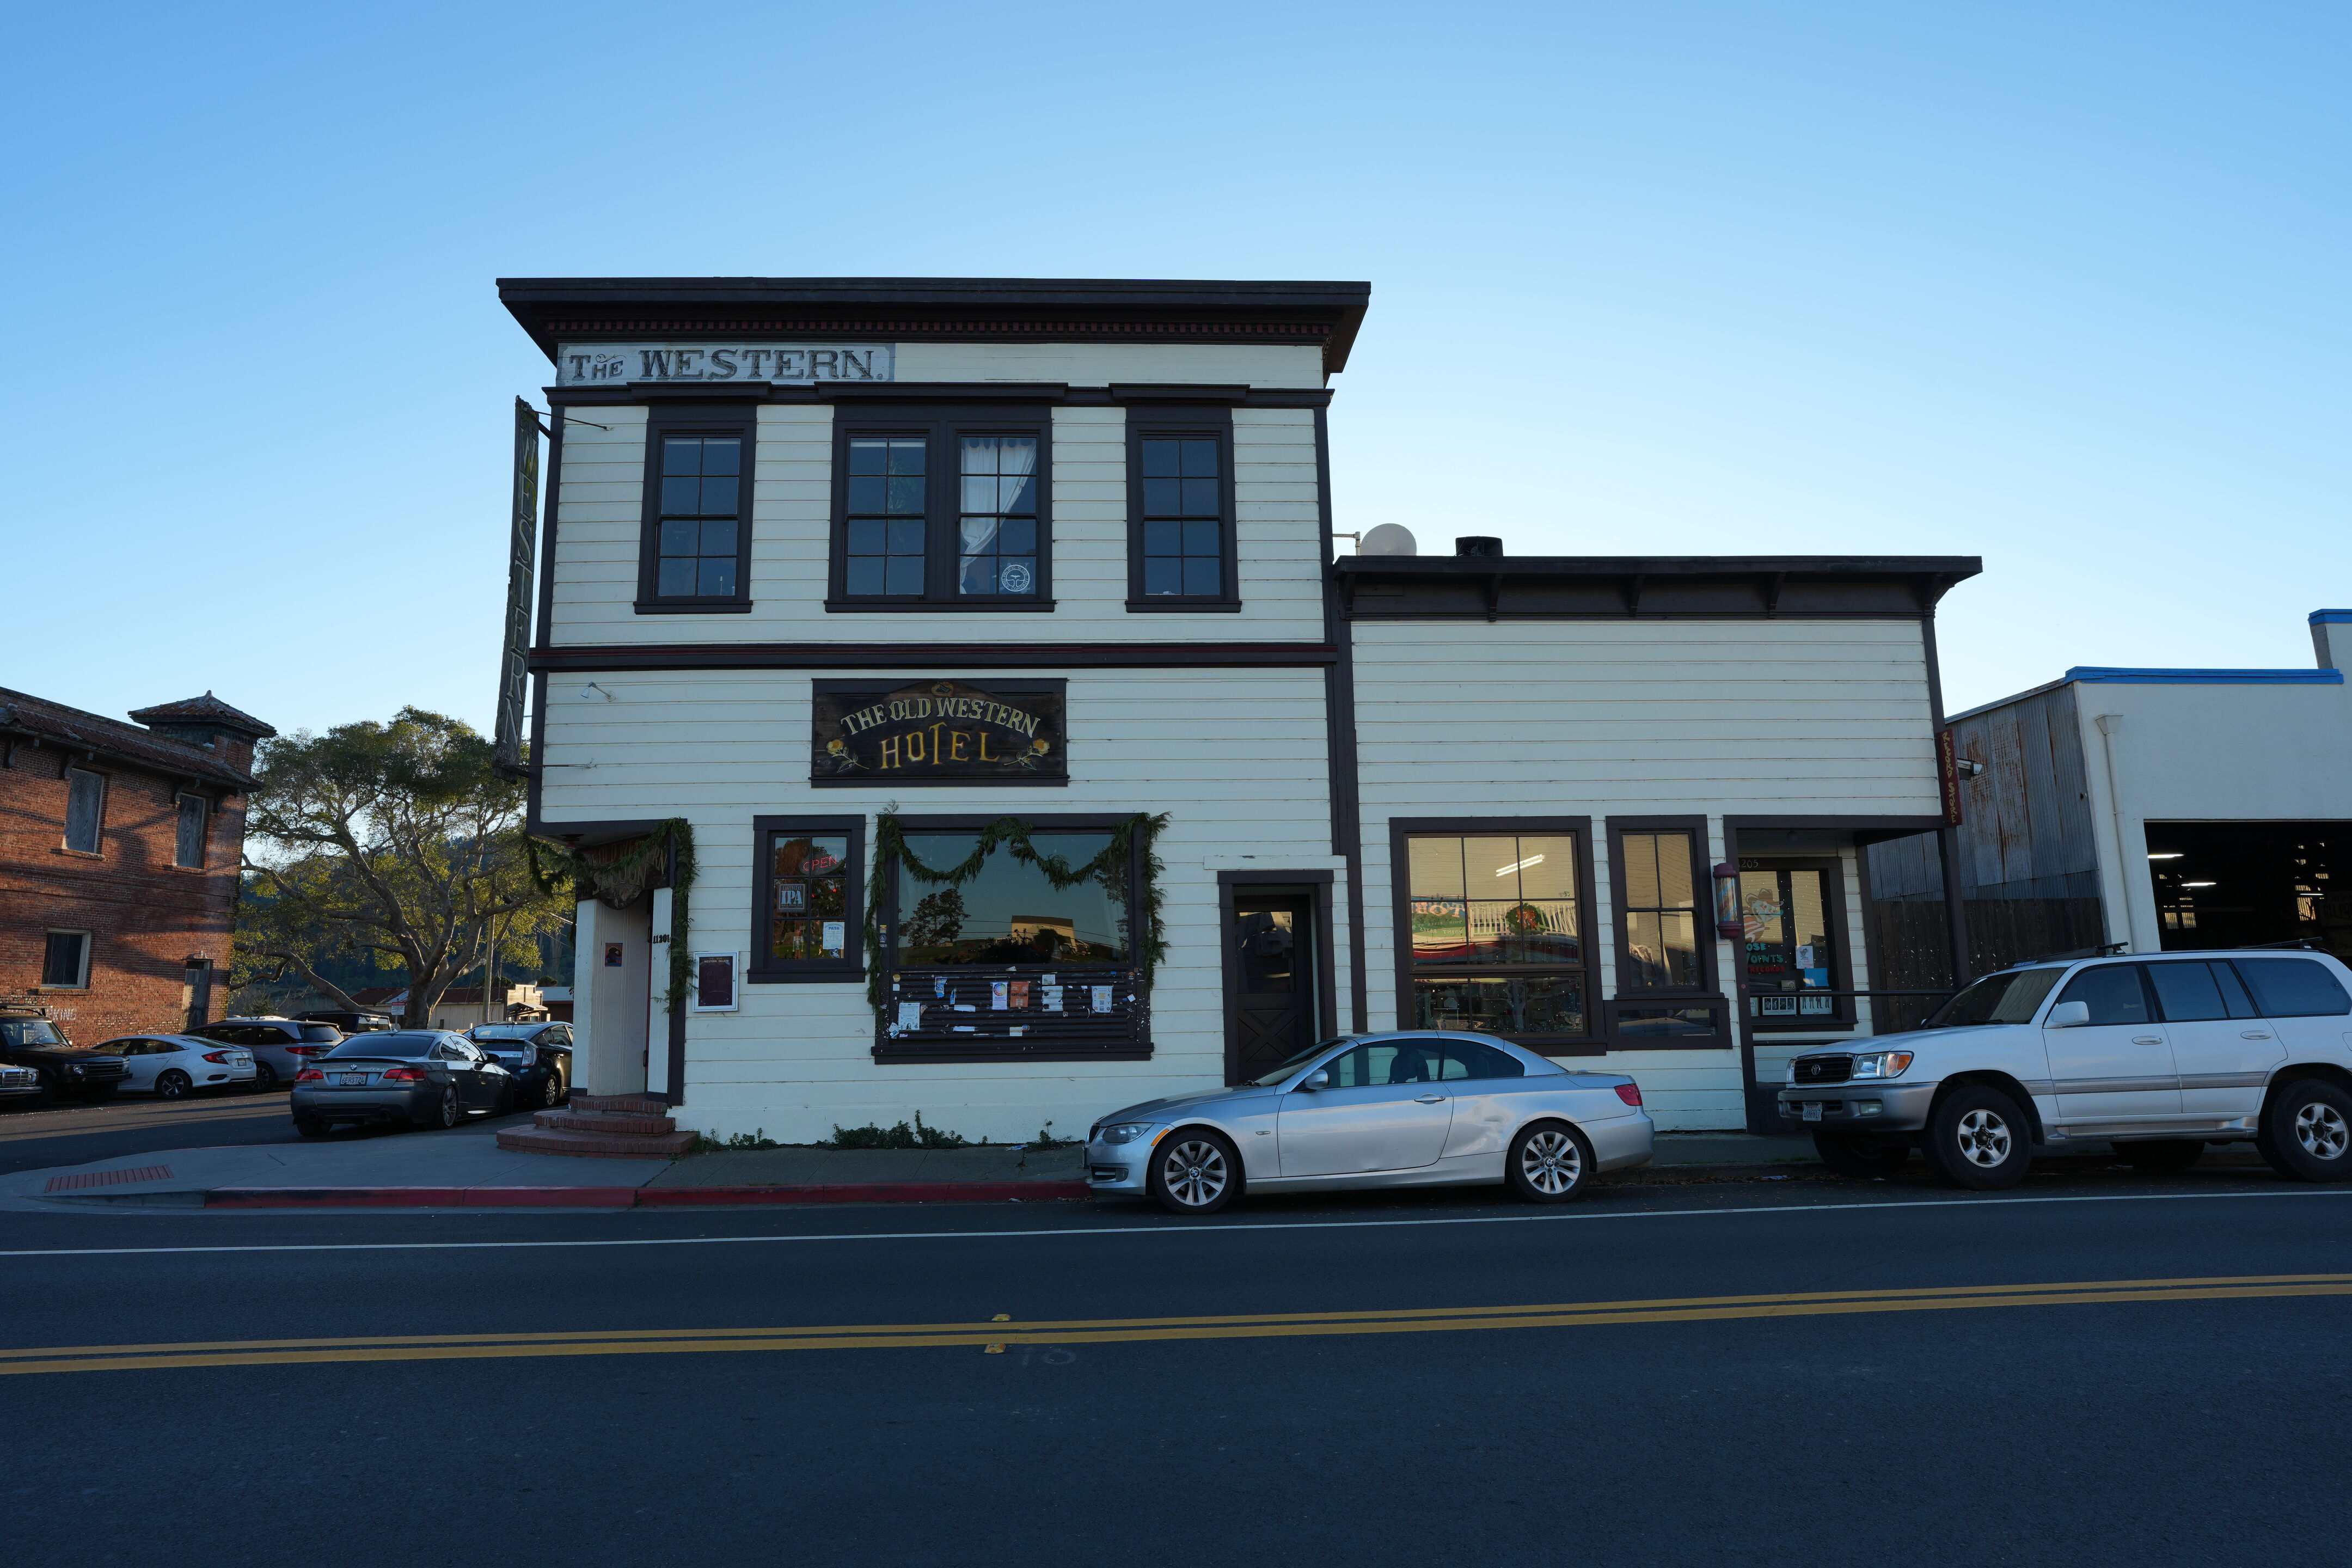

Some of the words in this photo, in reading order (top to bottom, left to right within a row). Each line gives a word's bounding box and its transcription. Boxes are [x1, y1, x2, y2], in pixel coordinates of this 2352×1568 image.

[570, 355, 623, 379] THE
[639, 349, 883, 379] WESTERN.
[501, 426, 538, 749] WESTERN
[841, 704, 887, 736] THE
[889, 698, 932, 720] OLD
[936, 697, 1040, 738] WESTERN
[879, 721, 1001, 769] HOTEL
[1942, 731, 1953, 779] RECORD
[1947, 782, 1958, 824] STORE
[803, 855, 837, 871] OPEN
[781, 891, 803, 904] IPA
[653, 934, 670, 944] 11201
